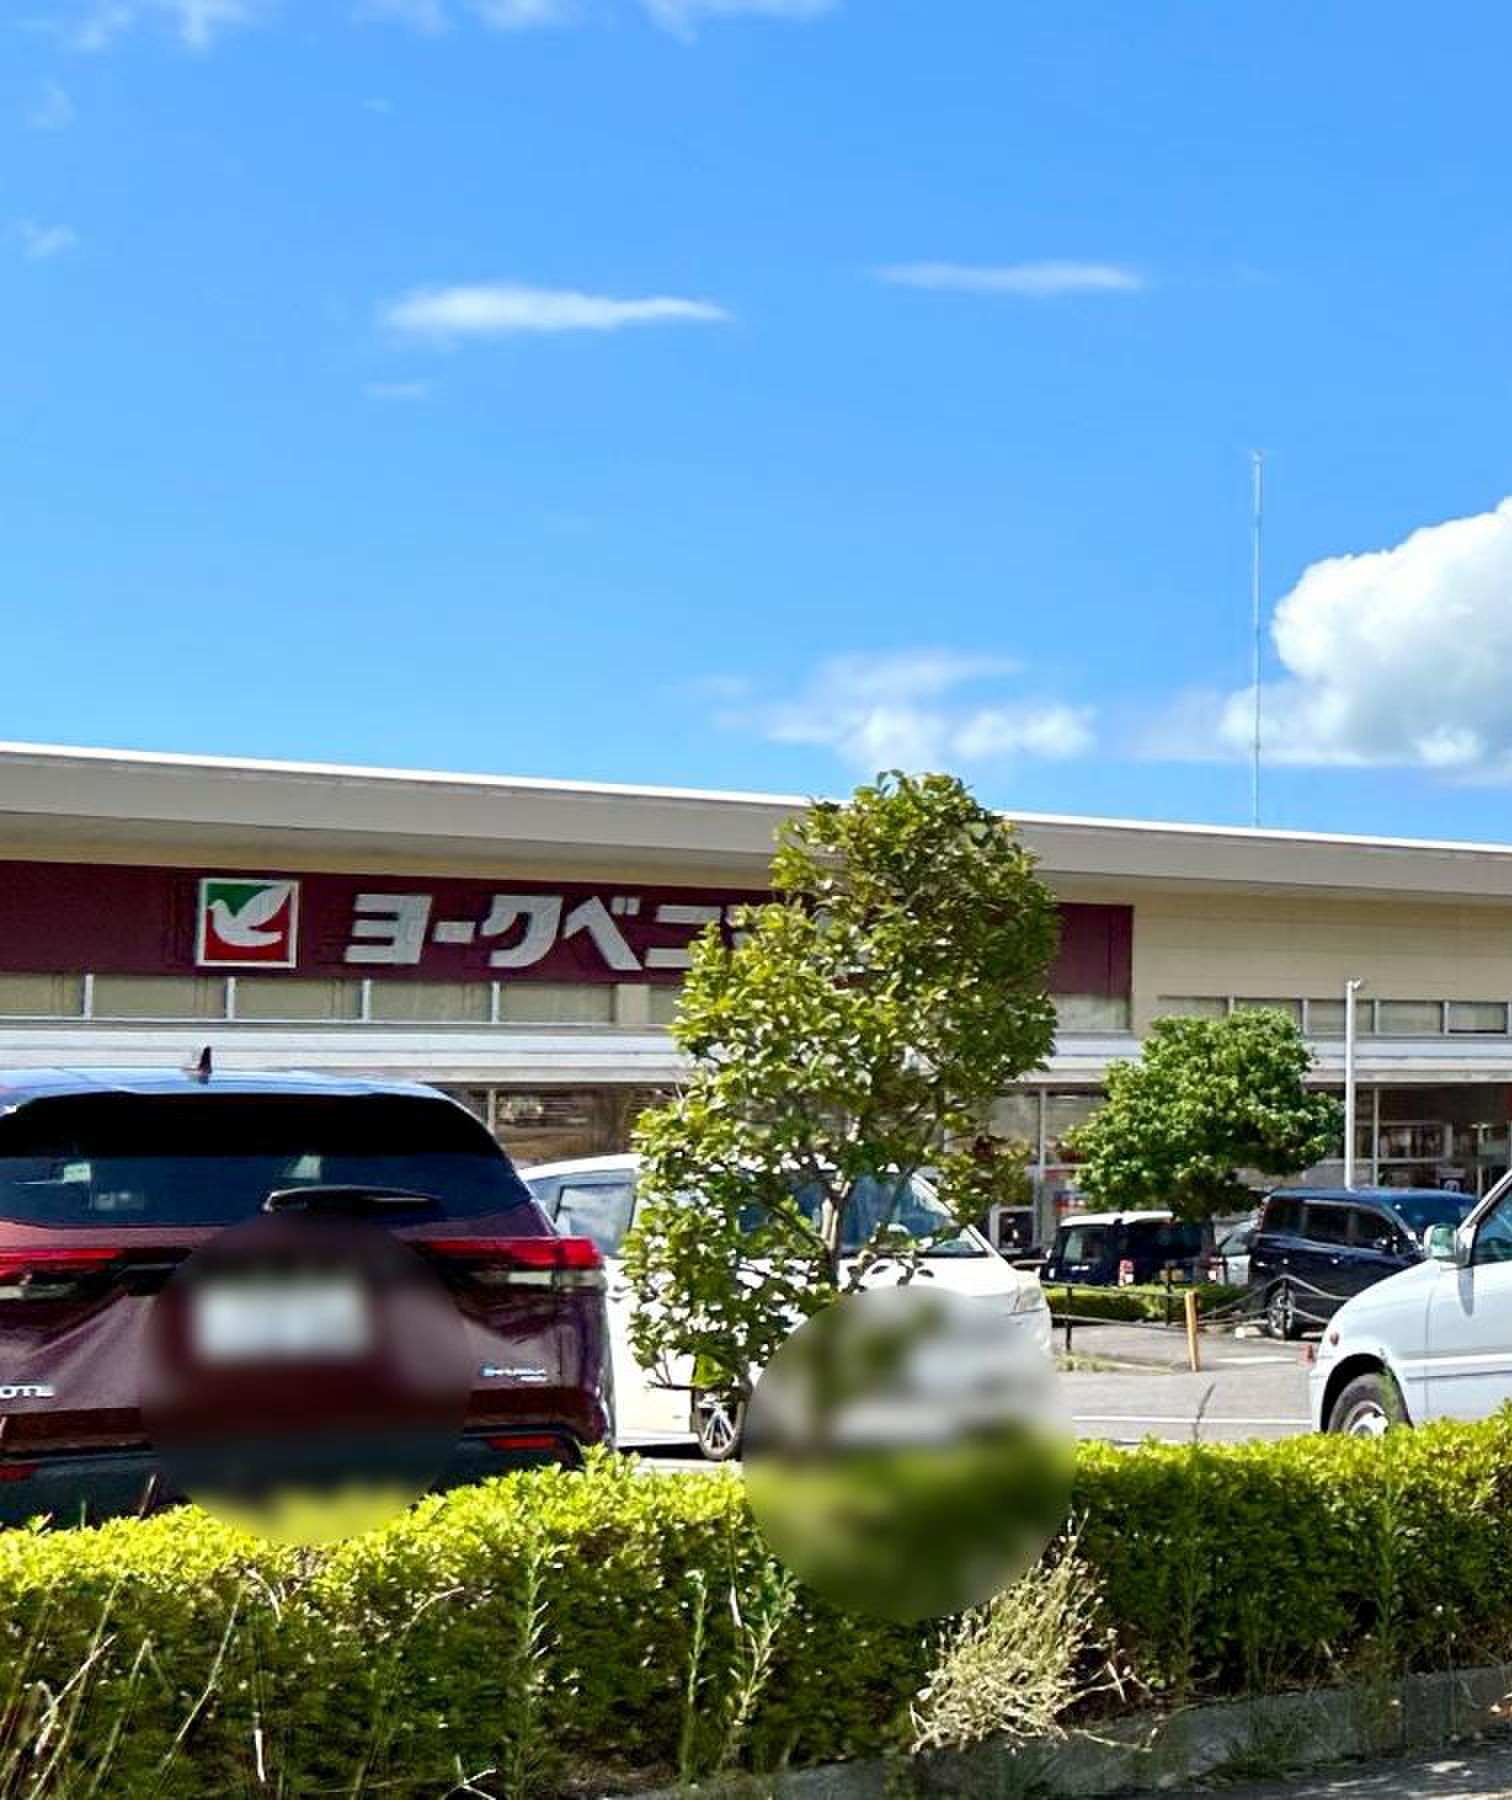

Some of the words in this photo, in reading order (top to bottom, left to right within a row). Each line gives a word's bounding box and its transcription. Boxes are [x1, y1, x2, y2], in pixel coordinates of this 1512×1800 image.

[344, 893, 868, 972] ヨークベニ
